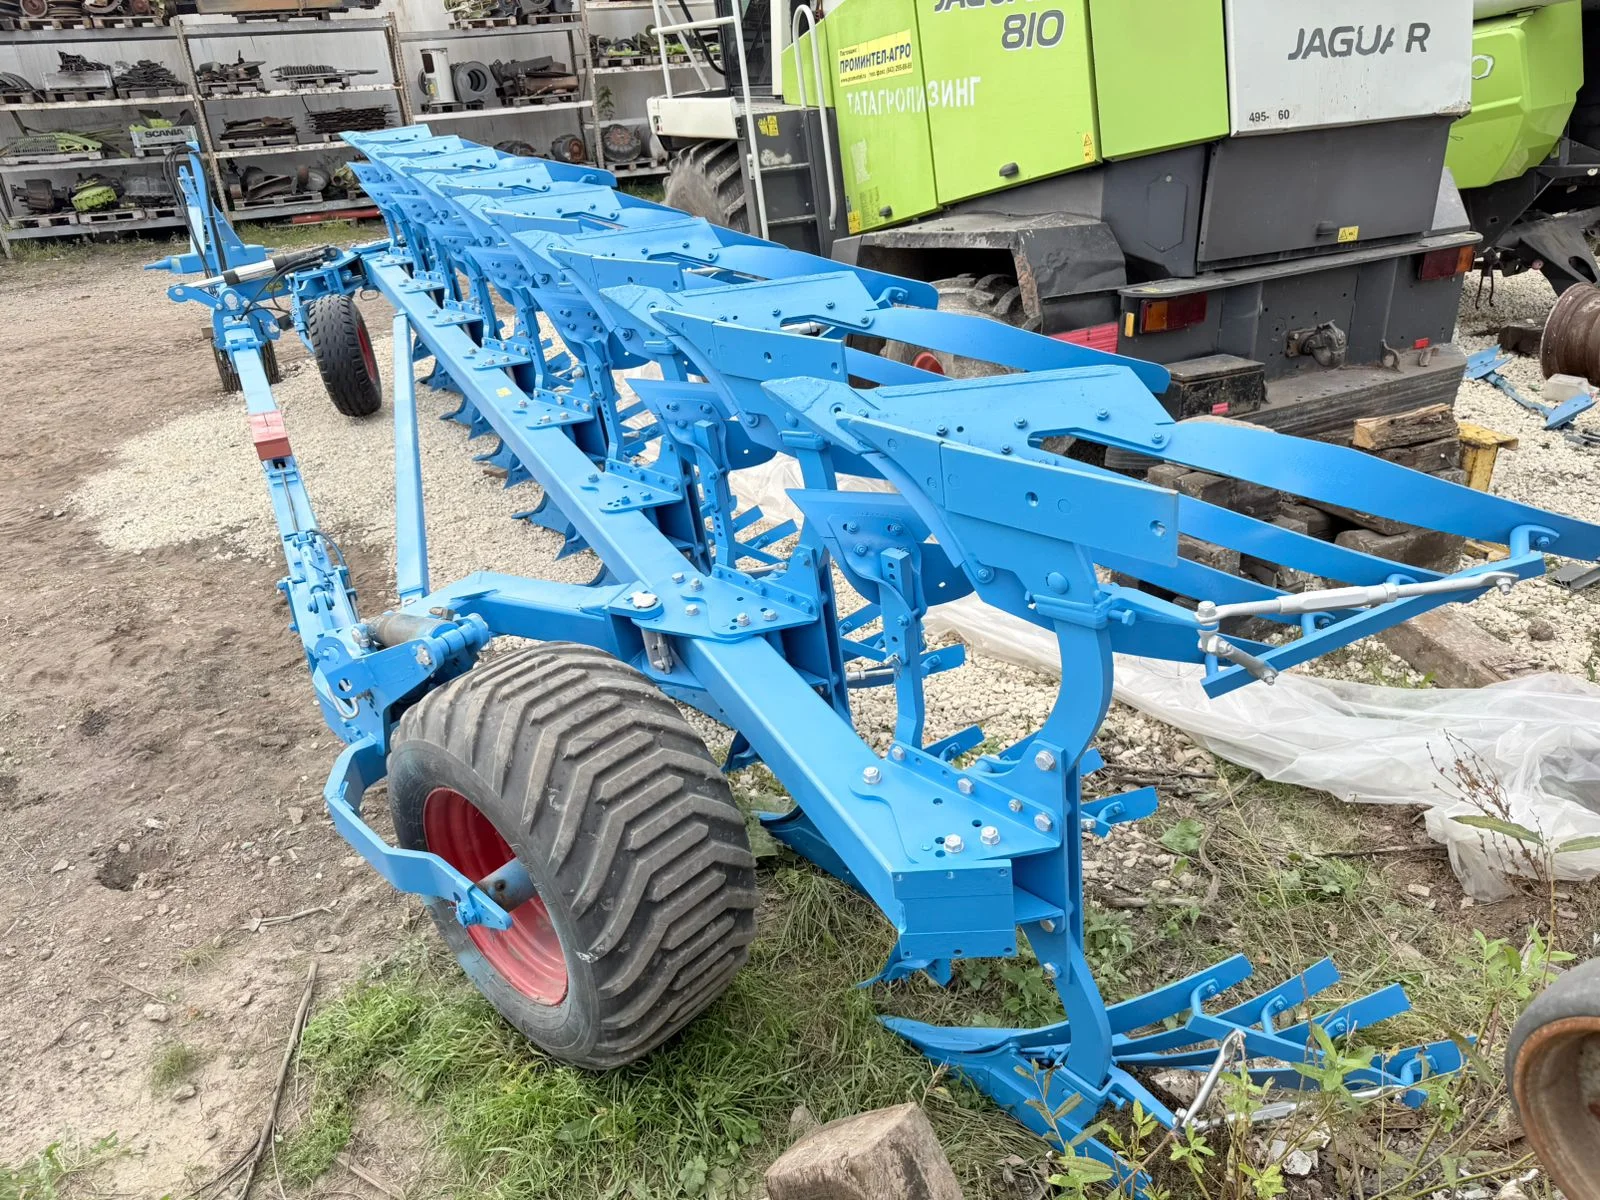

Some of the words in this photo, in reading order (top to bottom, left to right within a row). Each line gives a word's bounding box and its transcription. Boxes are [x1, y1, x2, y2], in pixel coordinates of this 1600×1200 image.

[1001, 9, 1064, 50] 810
[840, 43, 911, 73] ПРОМИНТЕЛ-АГРО
[1278, 109, 1290, 120] 60
[144, 128, 185, 138] SCANIA
